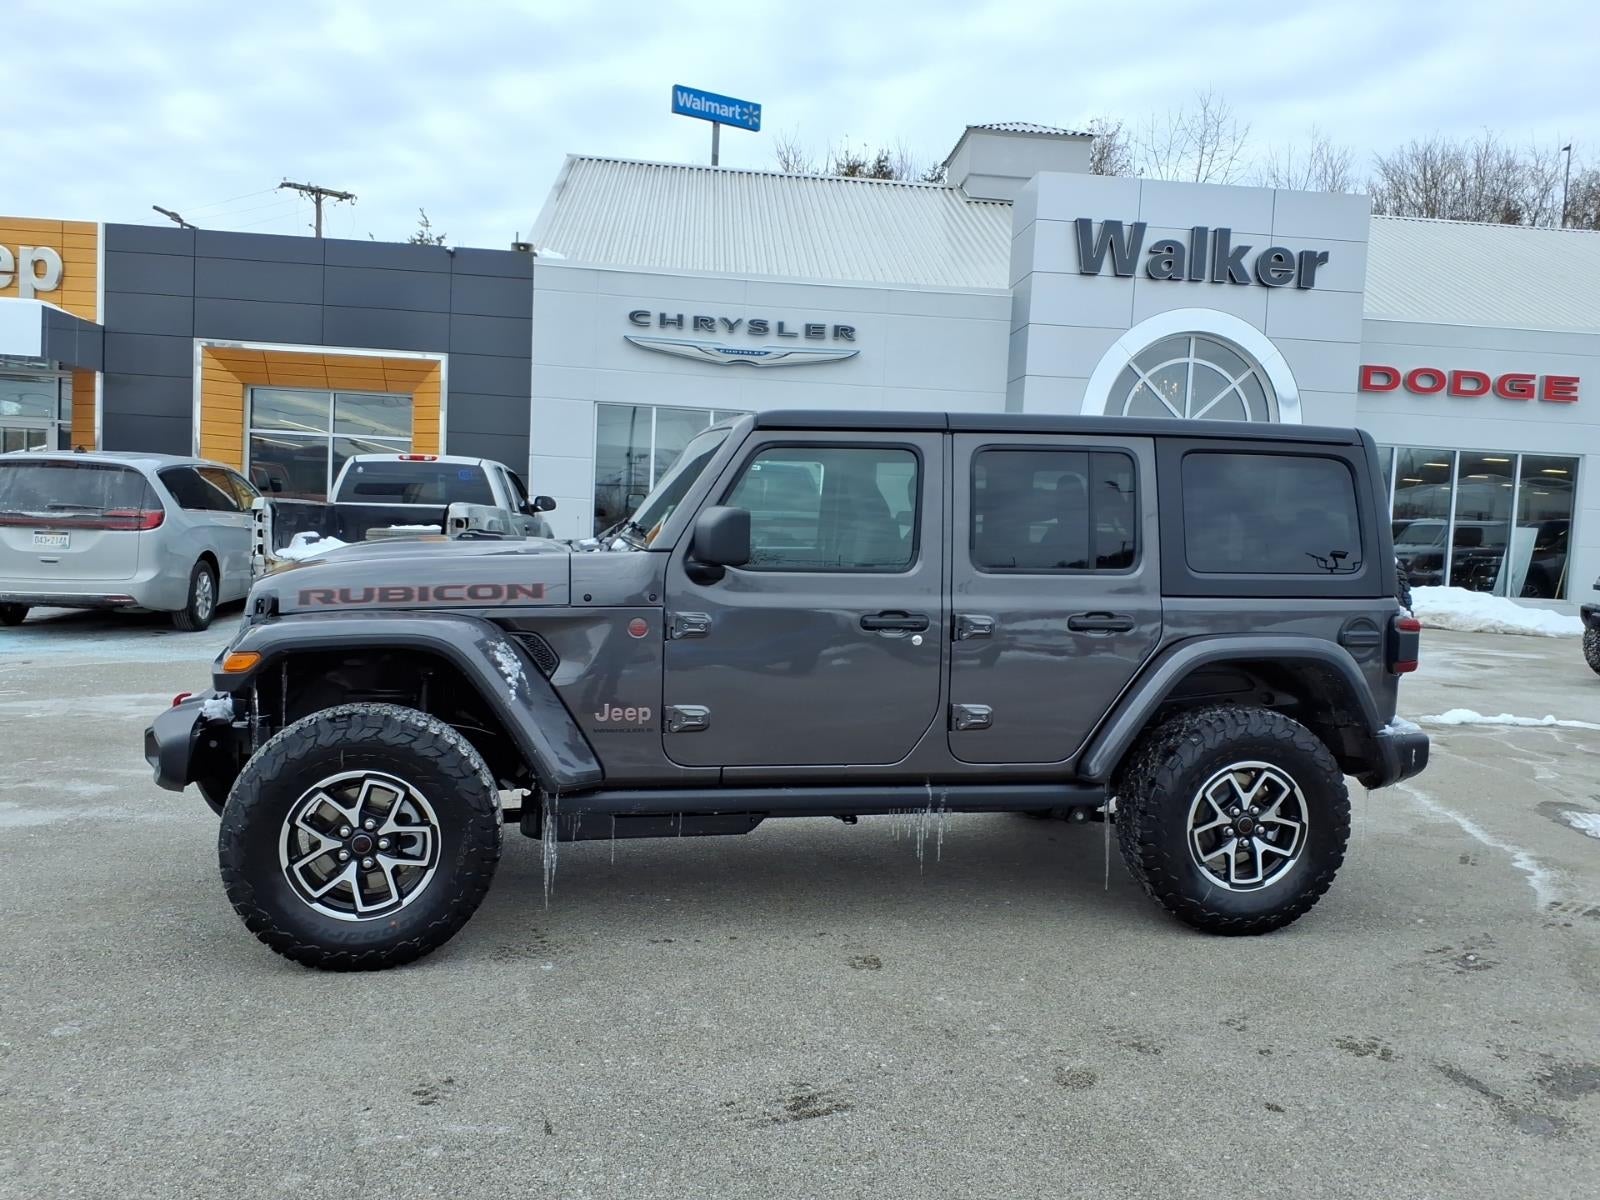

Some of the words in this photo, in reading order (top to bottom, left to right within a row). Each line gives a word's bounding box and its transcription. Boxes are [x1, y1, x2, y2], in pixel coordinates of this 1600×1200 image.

[677, 90, 741, 120] Walmart
[1075, 217, 1330, 289] Walker
[628, 309, 857, 342] CHRYSLER
[1358, 364, 1580, 403] DODGE
[298, 582, 546, 605] RUBICON
[594, 703, 652, 725] Jeep
